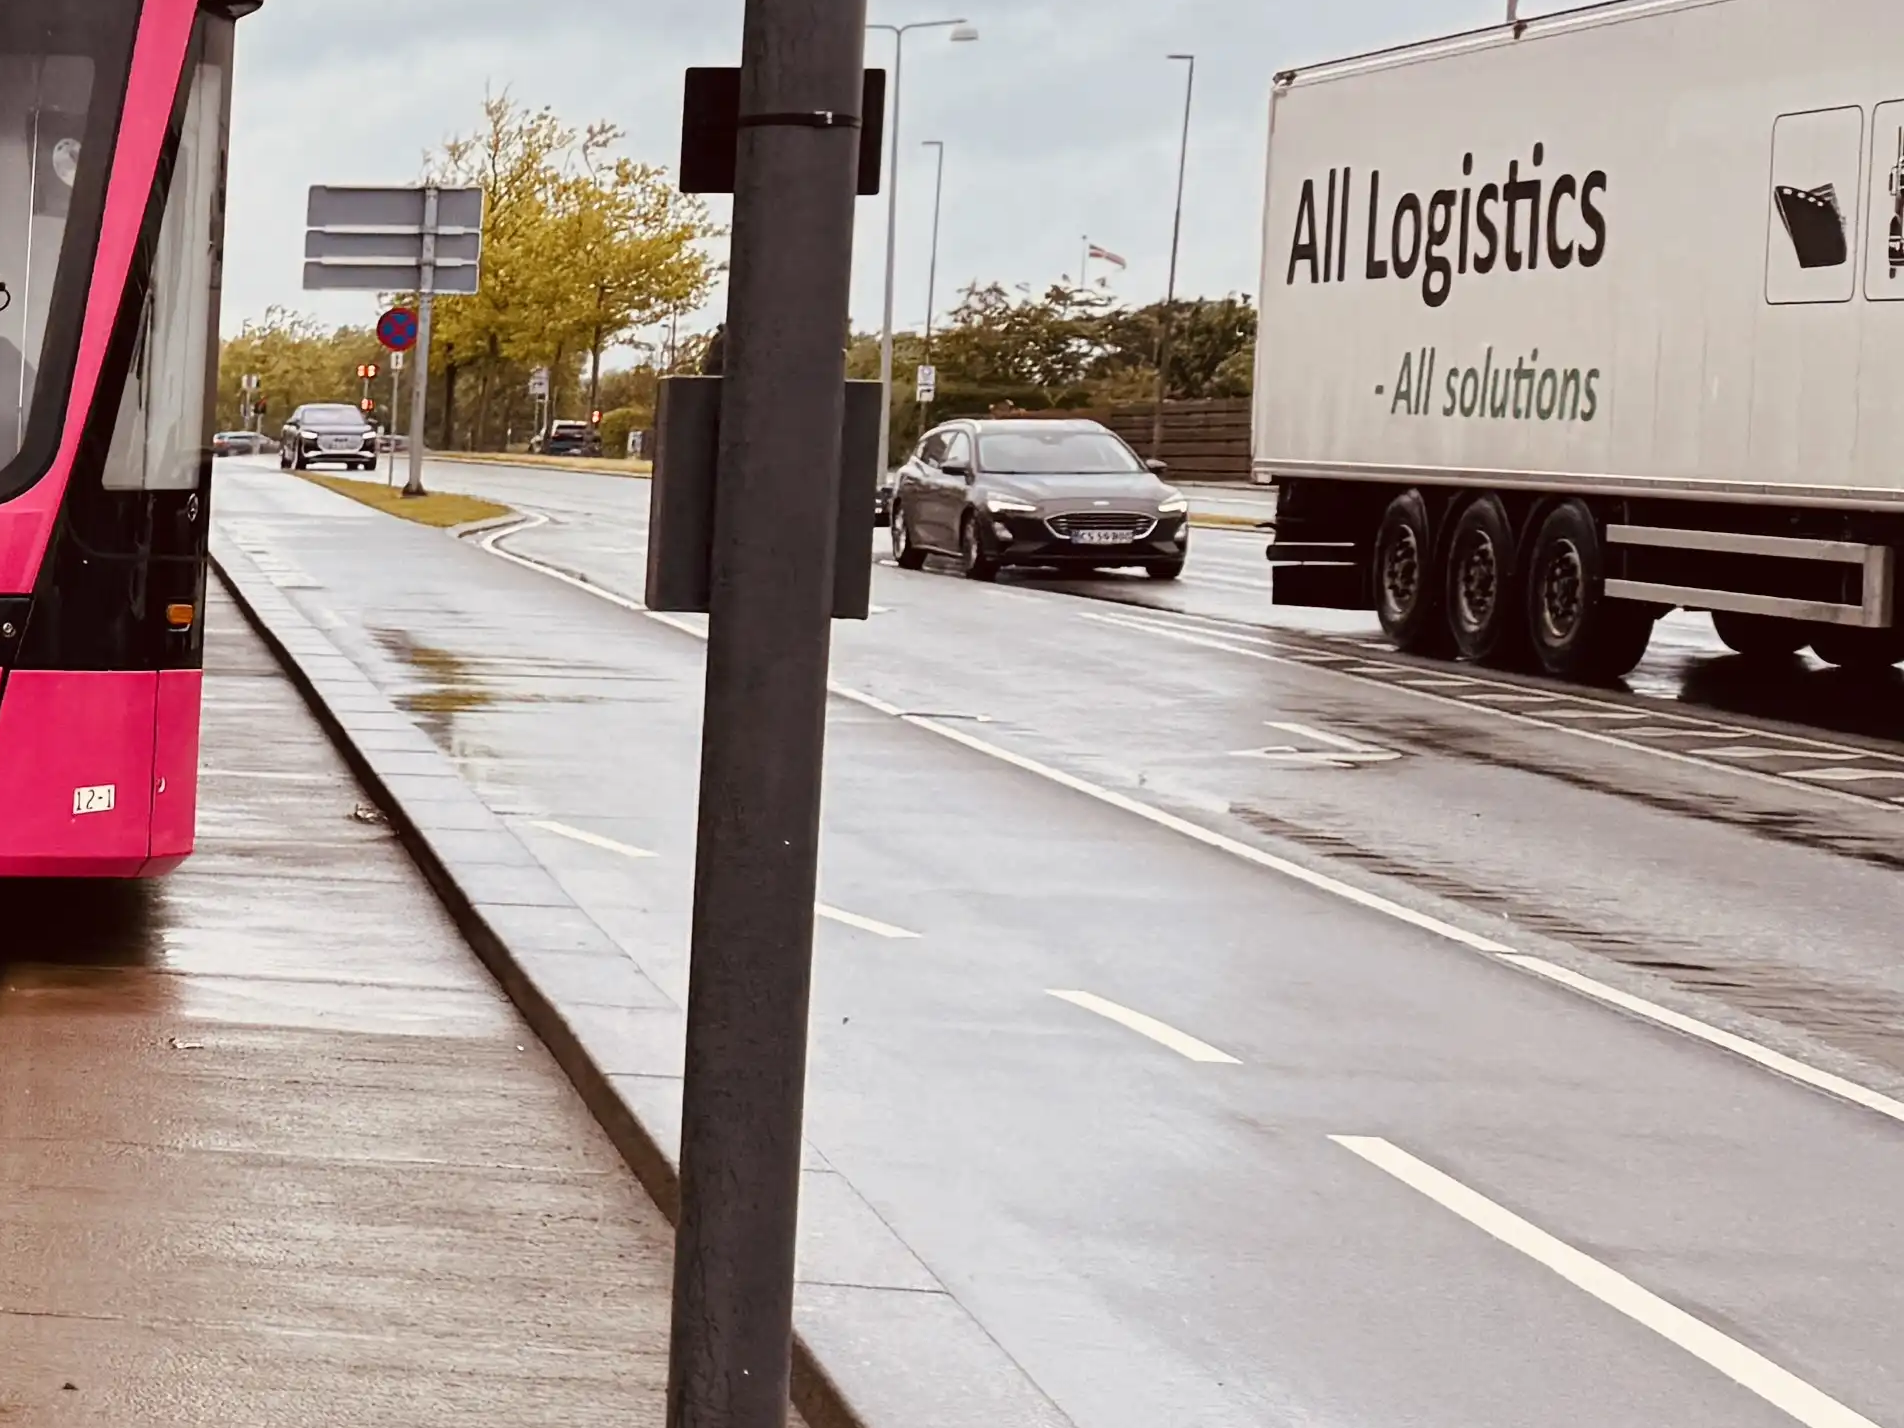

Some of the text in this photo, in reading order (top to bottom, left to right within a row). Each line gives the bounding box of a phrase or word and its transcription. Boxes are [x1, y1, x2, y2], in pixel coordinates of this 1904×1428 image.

[1286, 142, 1607, 307] All Logistics
[1391, 347, 1435, 416] All
[1442, 346, 1600, 422] solutions
[76, 789, 112, 811] 12-1
